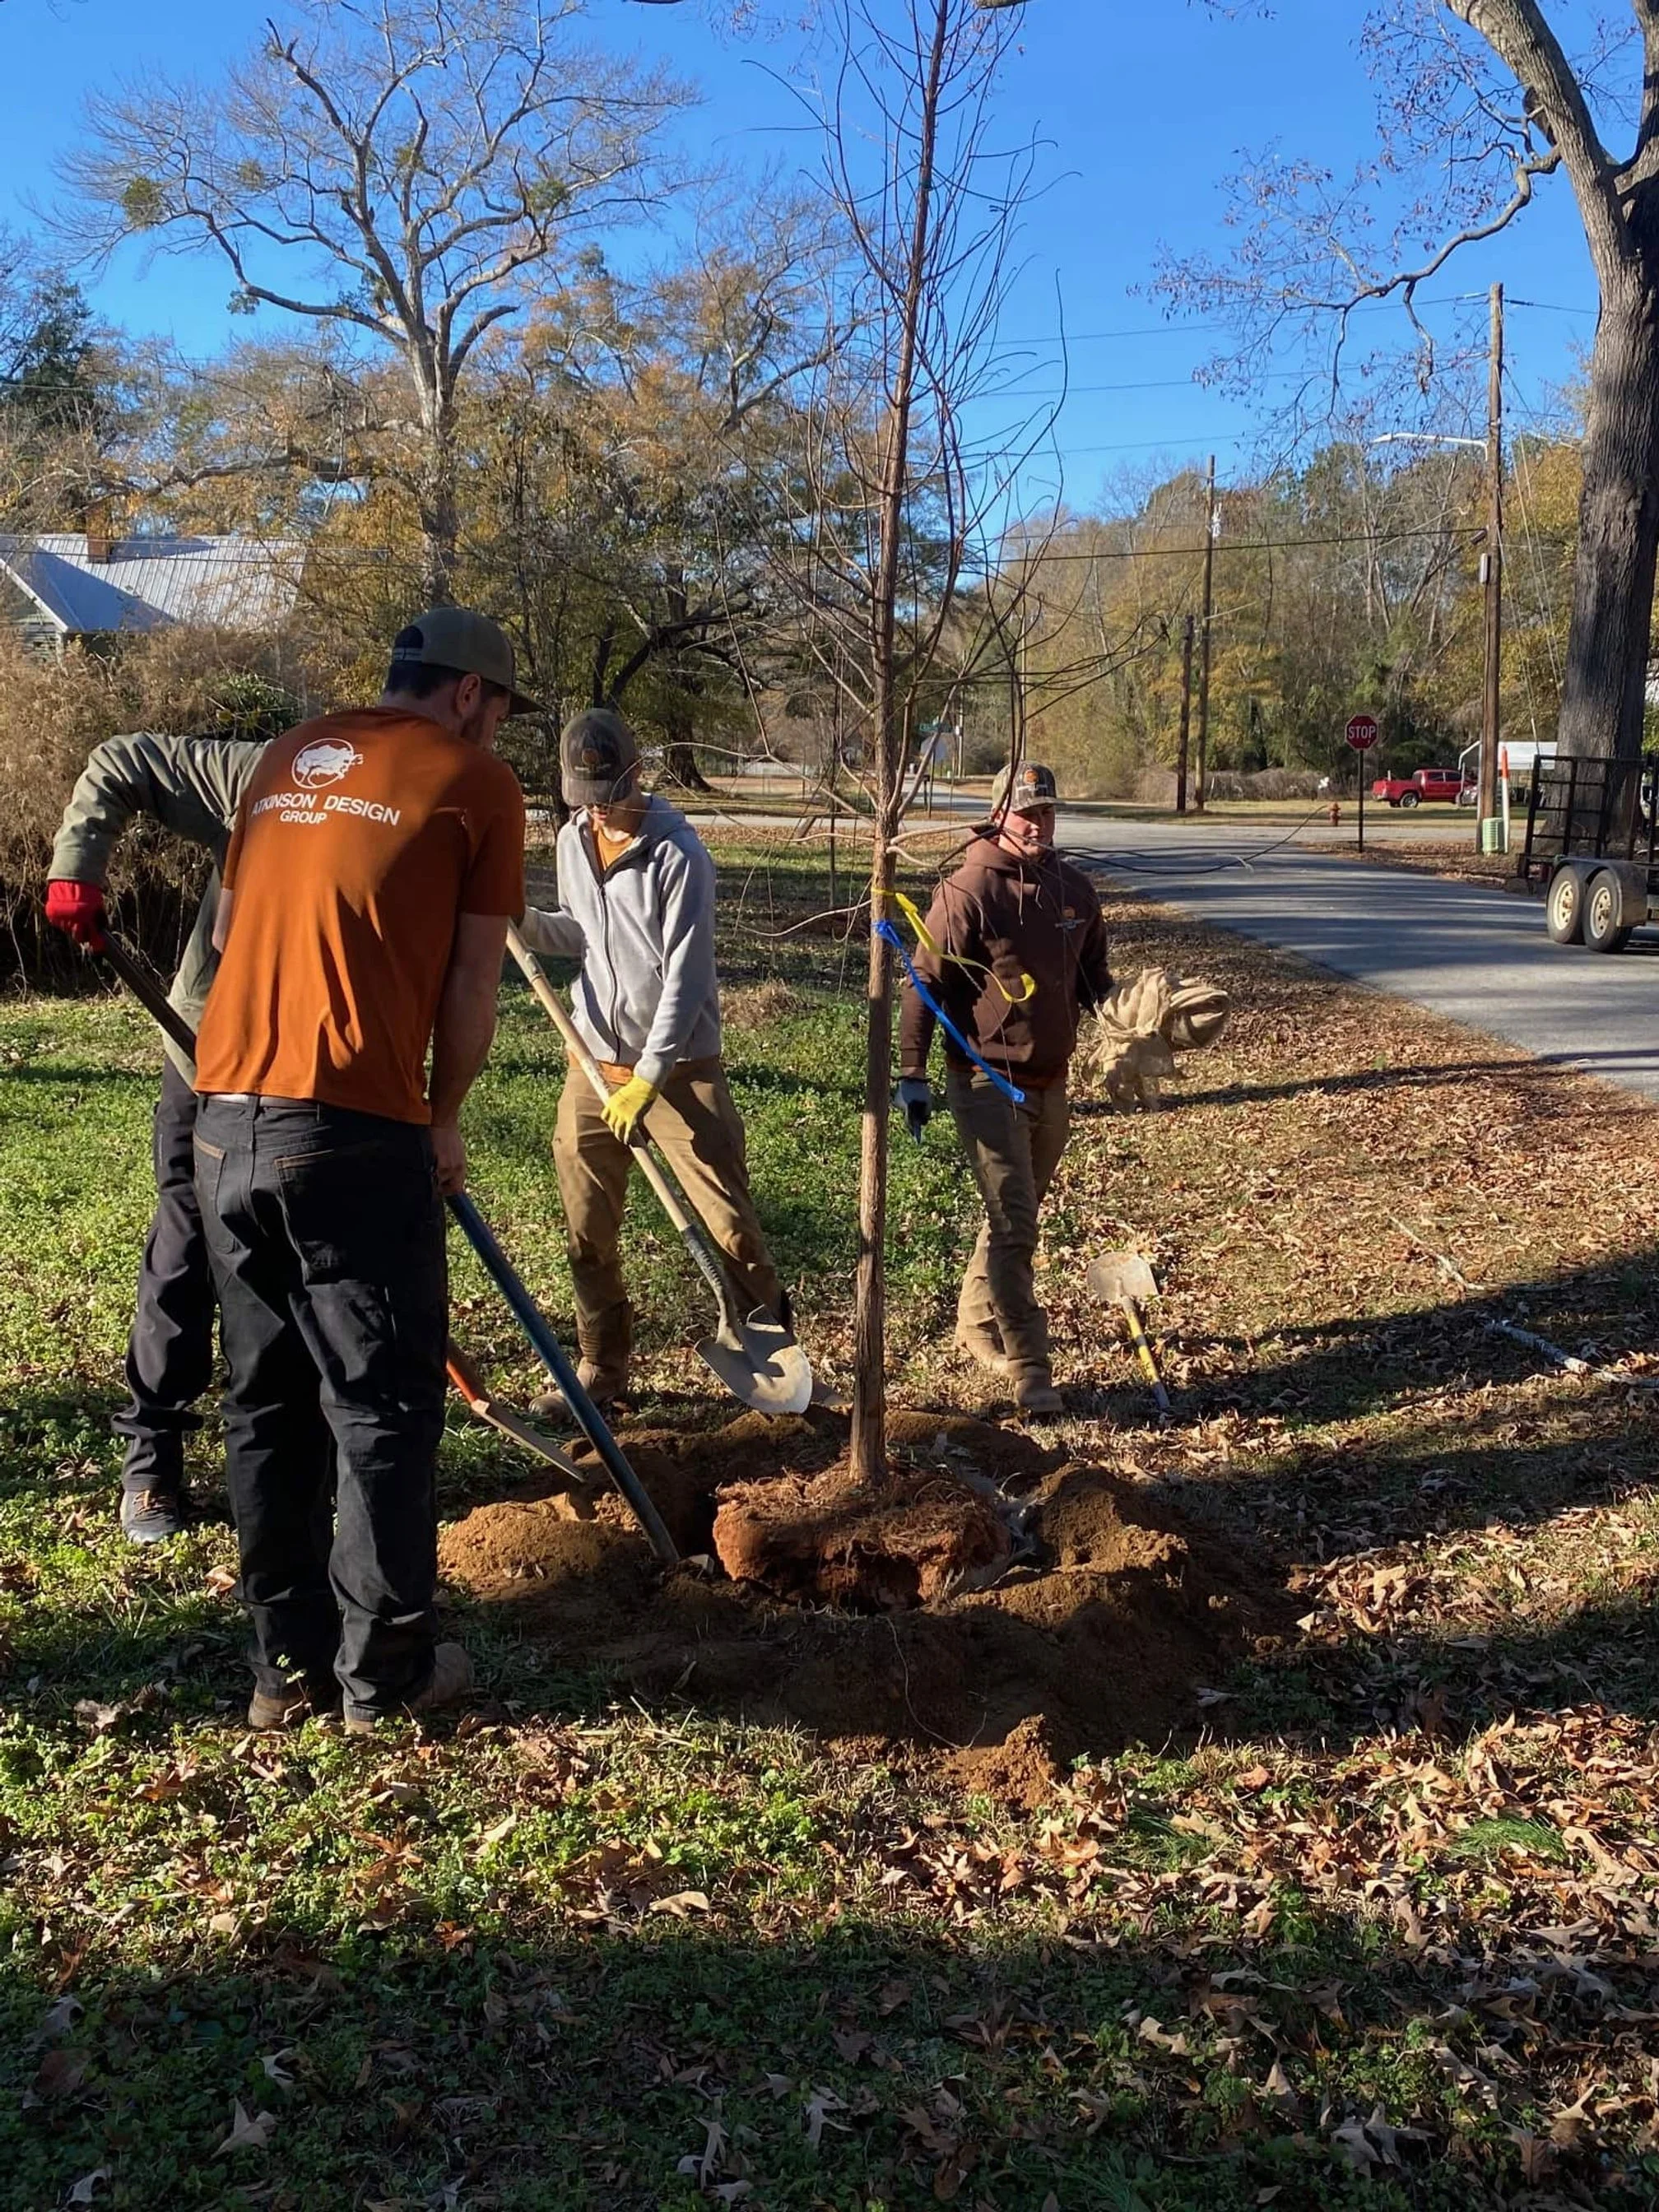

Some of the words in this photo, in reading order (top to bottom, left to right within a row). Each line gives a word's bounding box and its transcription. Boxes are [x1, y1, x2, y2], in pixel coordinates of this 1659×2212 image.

[1348, 725, 1376, 739] STOP
[251, 792, 318, 817] ATKINSON
[323, 795, 401, 826] DESIGN
[279, 810, 328, 824] GROUP
